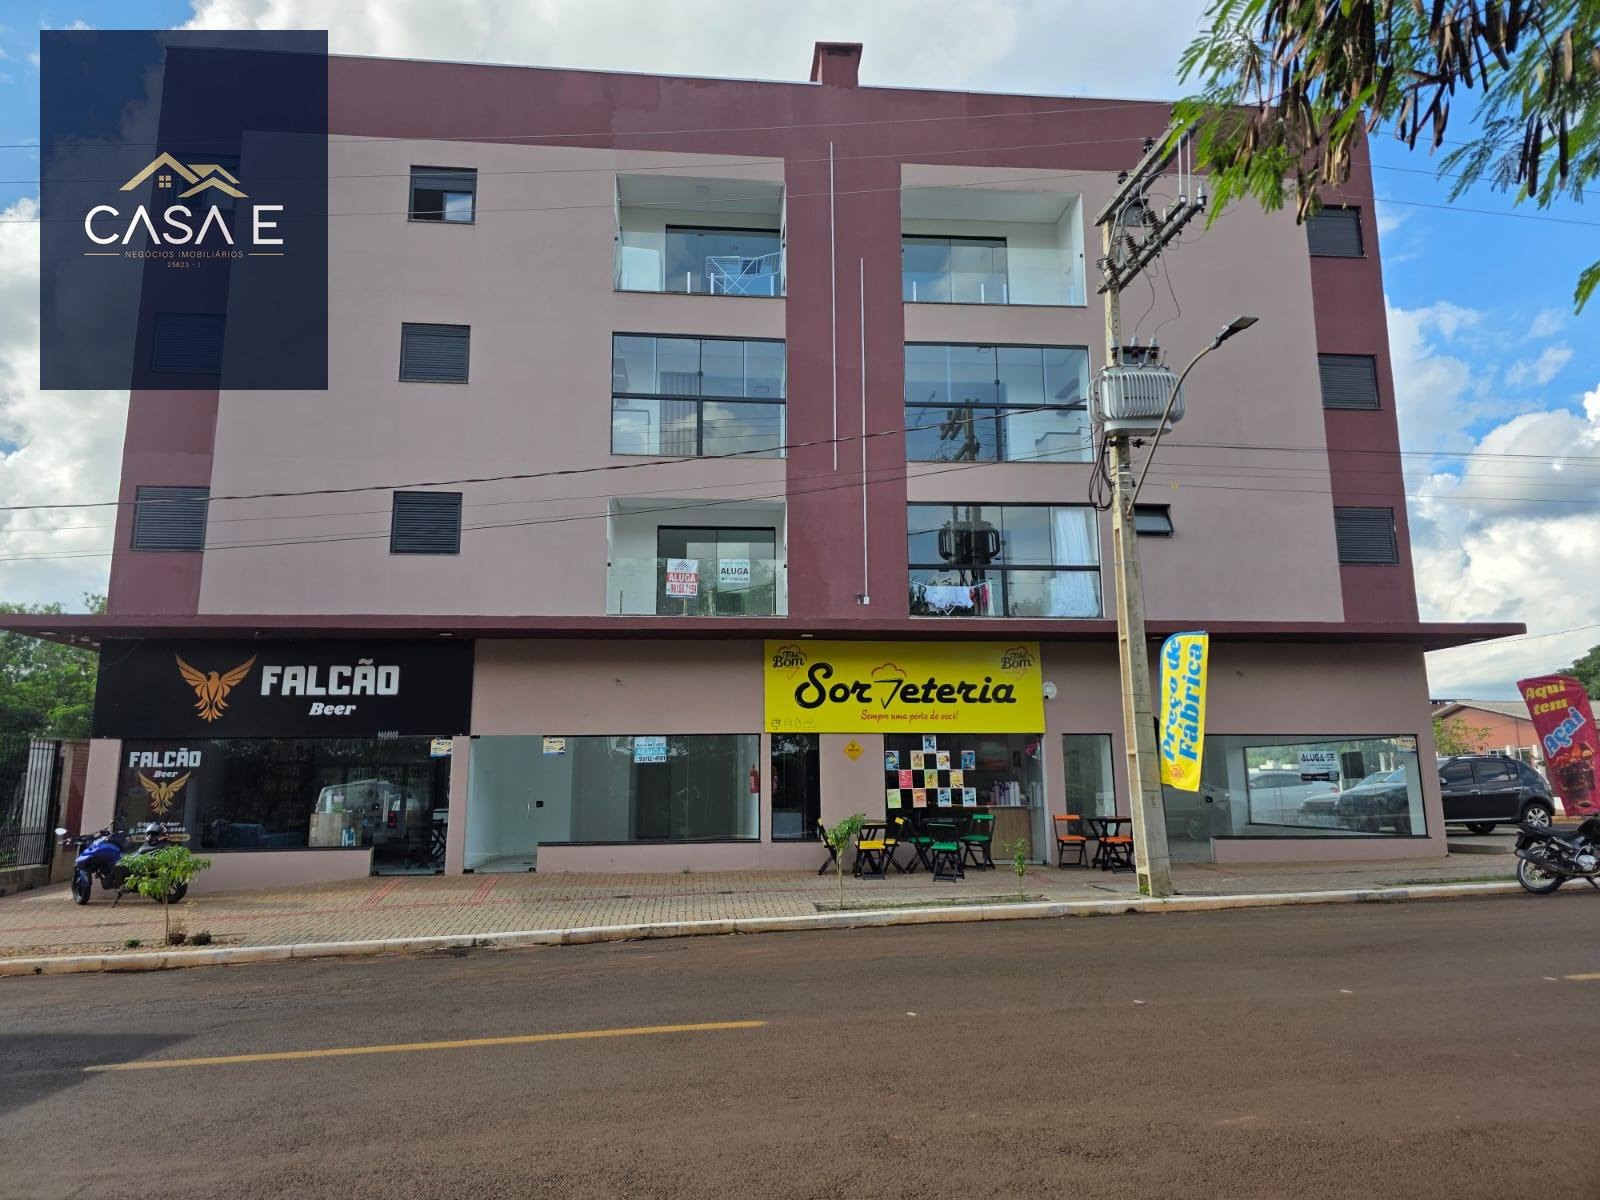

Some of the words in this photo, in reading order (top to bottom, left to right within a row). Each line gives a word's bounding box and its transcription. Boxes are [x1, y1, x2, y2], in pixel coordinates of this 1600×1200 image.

[668, 573, 697, 583] ALUGA
[720, 567, 749, 575] ALUGA
[772, 655, 806, 668] Bom
[1166, 638, 1182, 671] de
[1000, 657, 1033, 670] Bom
[260, 657, 401, 696] FALCÃO
[1526, 680, 1566, 700] Aqui
[308, 702, 357, 716] Beer
[1178, 643, 1203, 762] Fábrica
[1533, 698, 1569, 716] tem
[860, 709, 889, 725] Sempre
[909, 713, 929, 725] perto
[929, 709, 939, 720] de
[1162, 676, 1183, 762] Preço
[128, 747, 202, 768] FALCÃO
[636, 747, 666, 756] ALUGA
[153, 770, 179, 778] Beer
